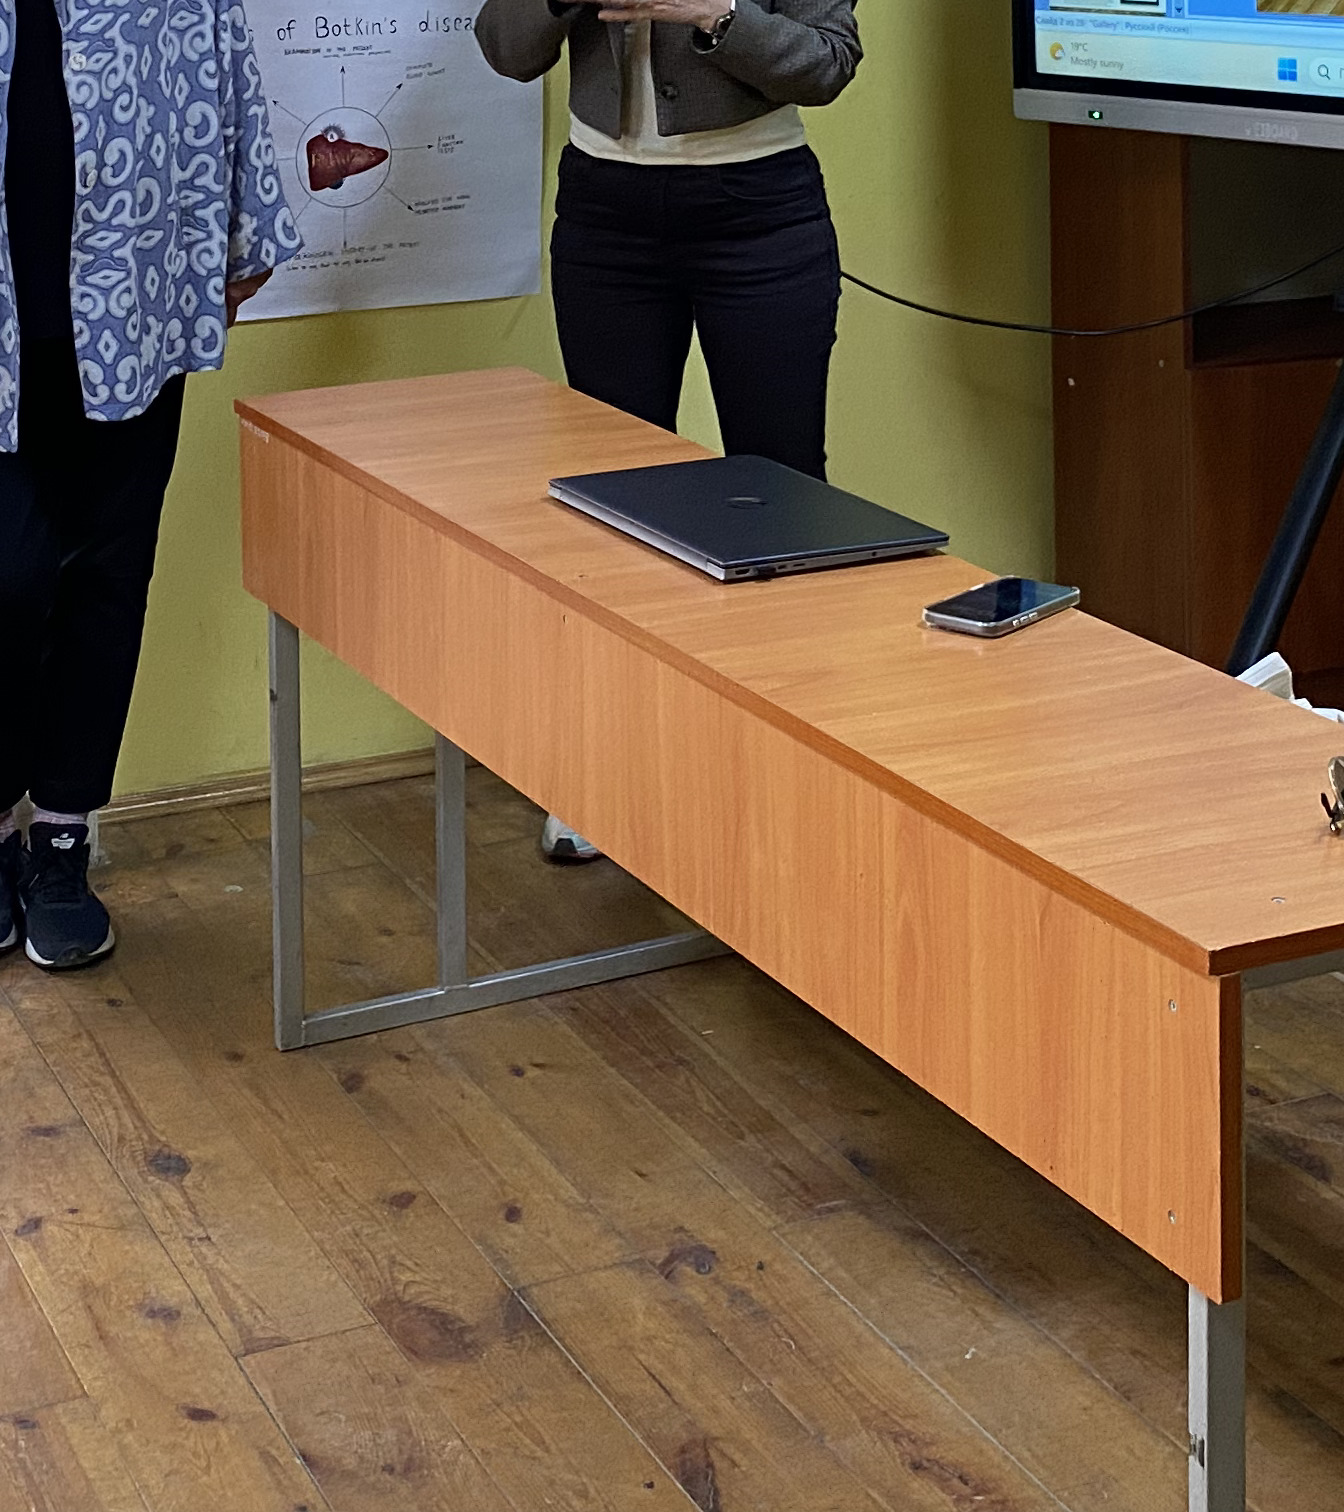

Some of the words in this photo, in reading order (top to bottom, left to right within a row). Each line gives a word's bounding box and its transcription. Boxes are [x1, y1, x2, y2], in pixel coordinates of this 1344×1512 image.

[277, 19, 296, 41] of
[315, 16, 398, 39] Botkin's
[418, 10, 474, 34] disea
[1070, 55, 1097, 69] Mostly
[1099, 59, 1124, 71] sunny
